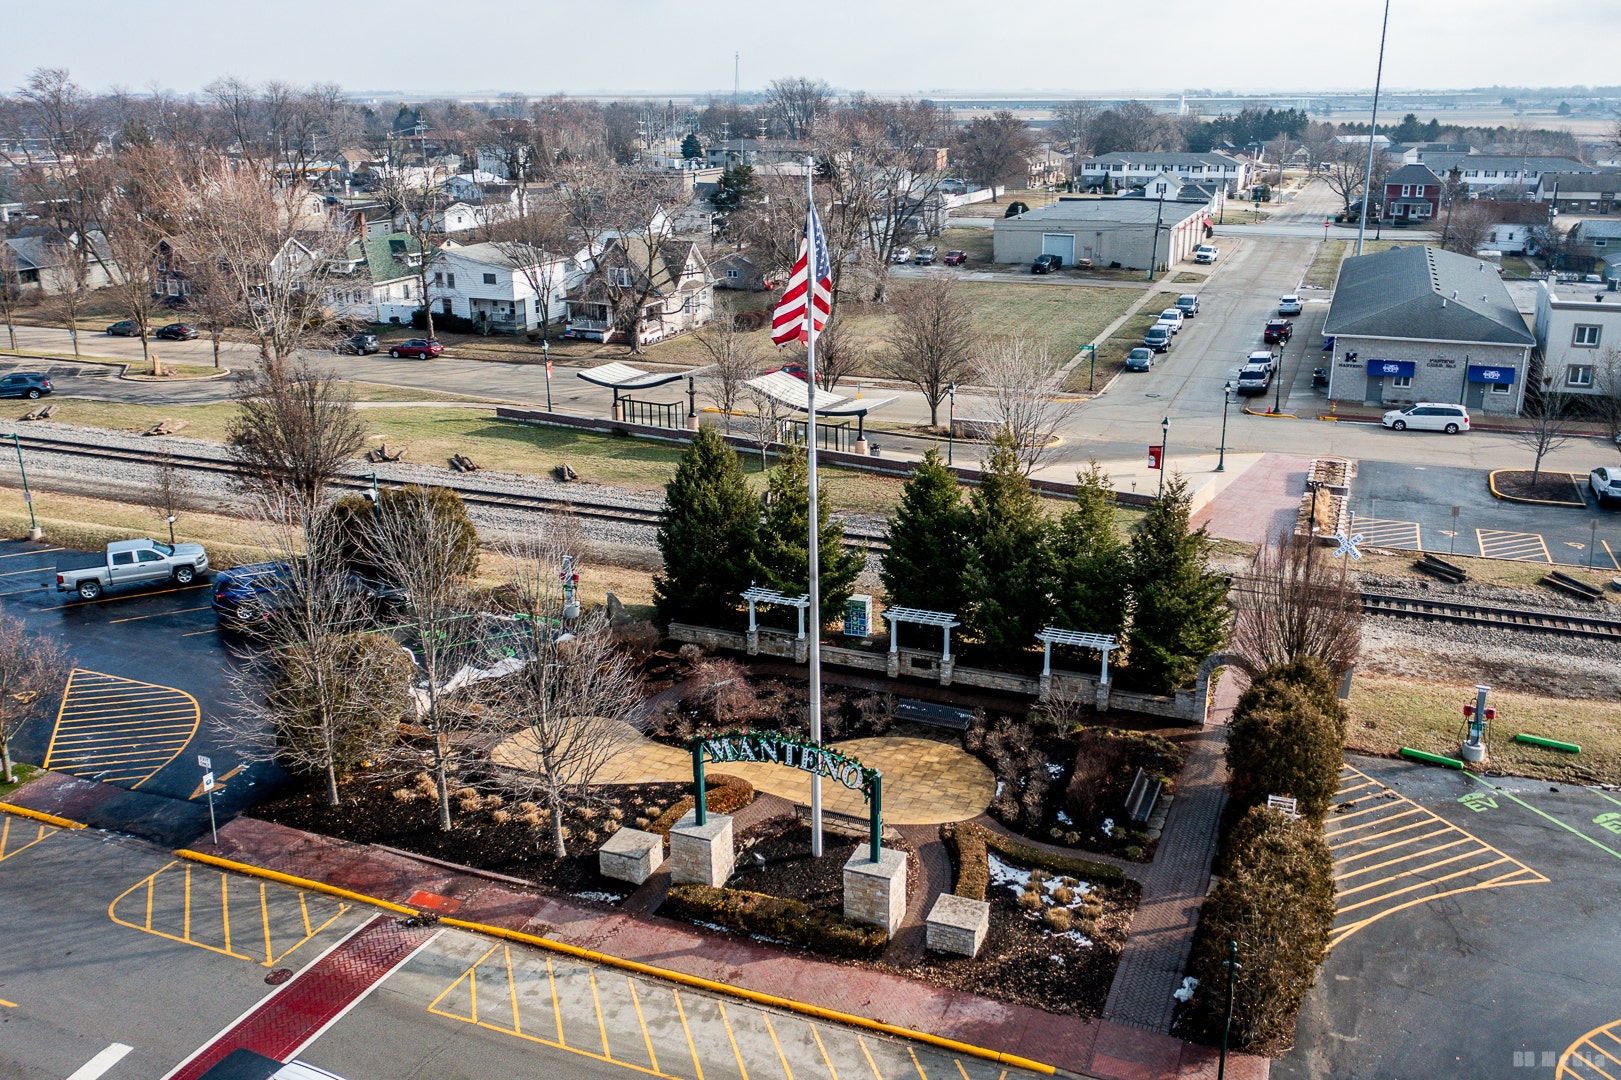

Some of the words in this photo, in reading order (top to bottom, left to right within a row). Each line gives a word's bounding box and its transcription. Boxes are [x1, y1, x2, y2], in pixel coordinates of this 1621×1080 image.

[708, 737, 864, 789] MANTENO
[1463, 797, 1499, 812] EV
[1600, 820, 1621, 834] E
